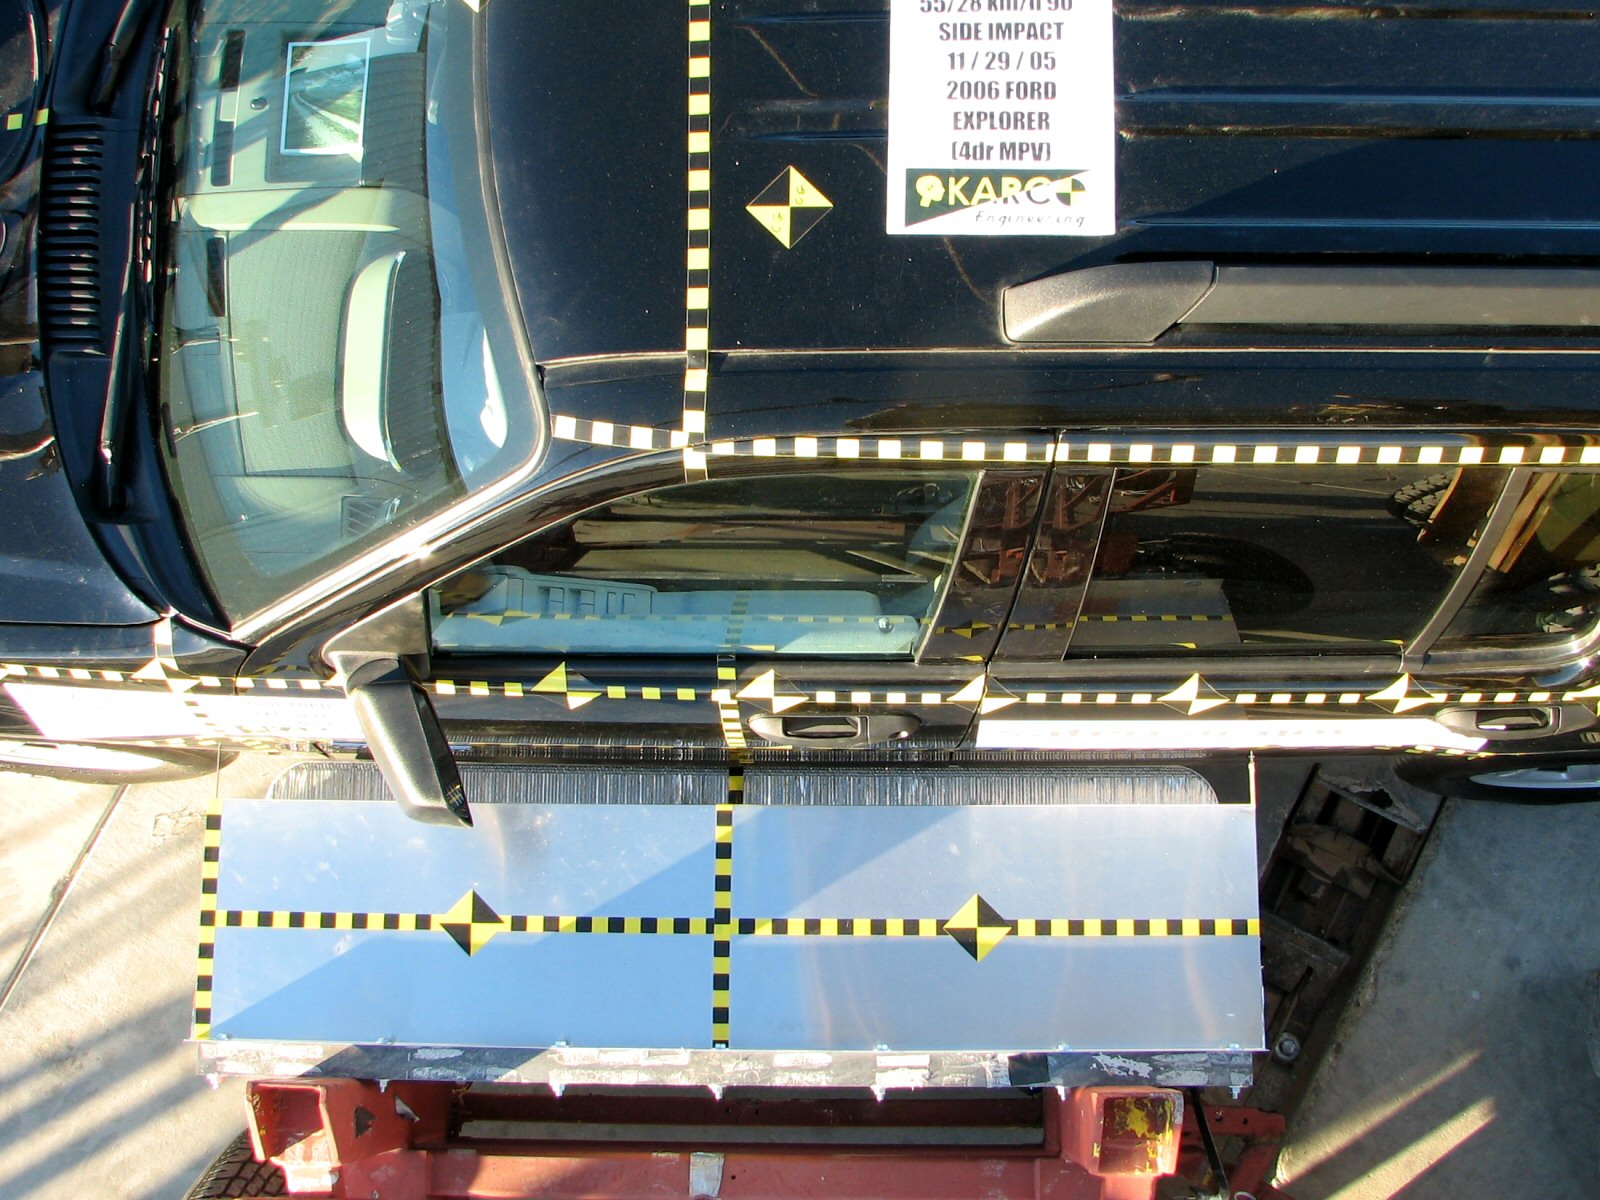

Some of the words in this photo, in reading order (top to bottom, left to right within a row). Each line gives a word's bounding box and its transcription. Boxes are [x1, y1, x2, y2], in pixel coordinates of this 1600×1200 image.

[920, 0, 981, 13] 55/28
[939, 22, 982, 41] SIDE
[988, 22, 1065, 41] IMPACT
[947, 80, 999, 100] 2006
[1005, 80, 1056, 100] FORD
[953, 110, 1049, 131] EXPLORER
[951, 141, 994, 161] (4dr
[999, 141, 1051, 161] MPV)
